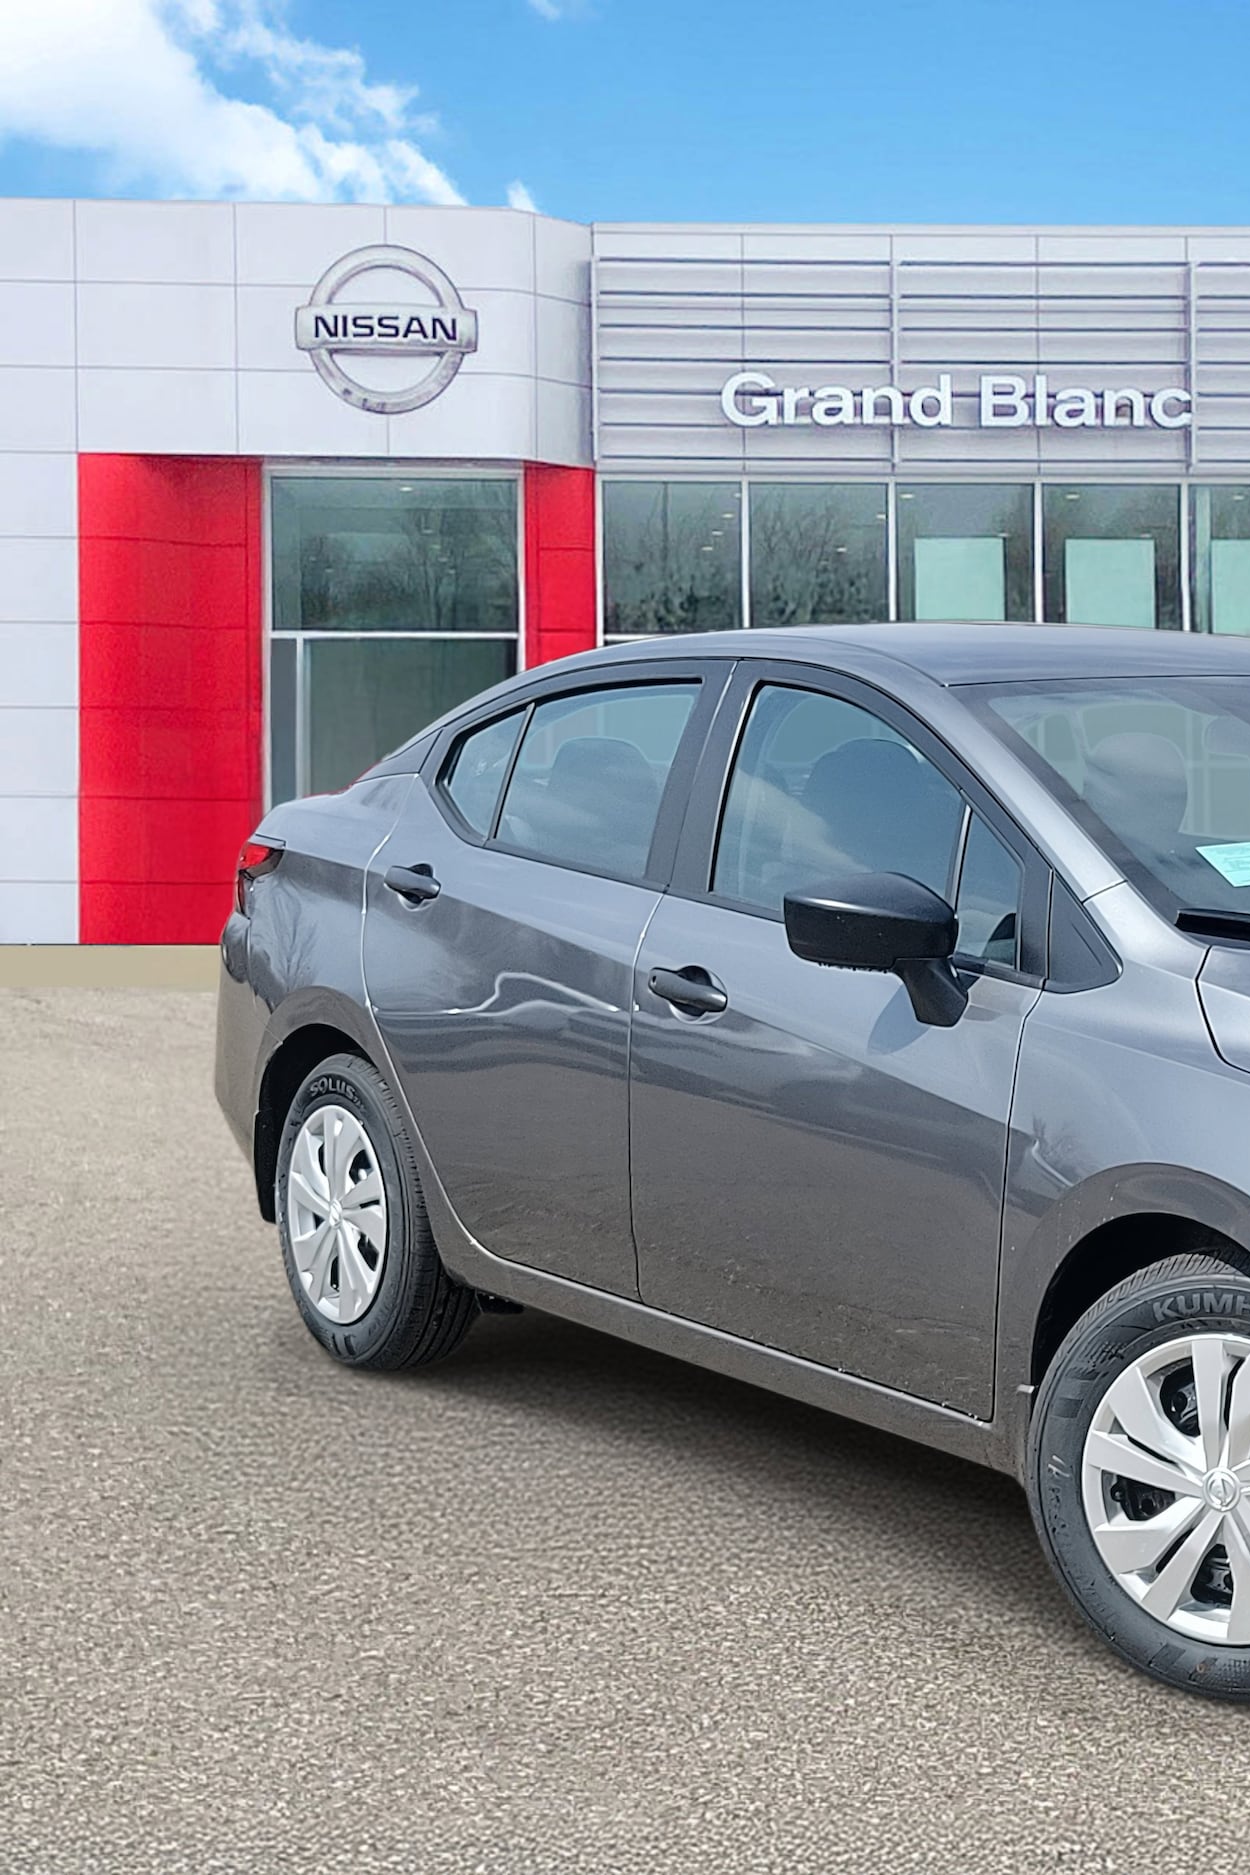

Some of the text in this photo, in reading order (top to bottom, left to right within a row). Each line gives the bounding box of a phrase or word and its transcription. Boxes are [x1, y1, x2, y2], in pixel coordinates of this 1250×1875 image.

[313, 314, 458, 342] NISSAN
[720, 371, 1193, 430] Grand Blanc
[310, 1076, 356, 1100] SOLUS
